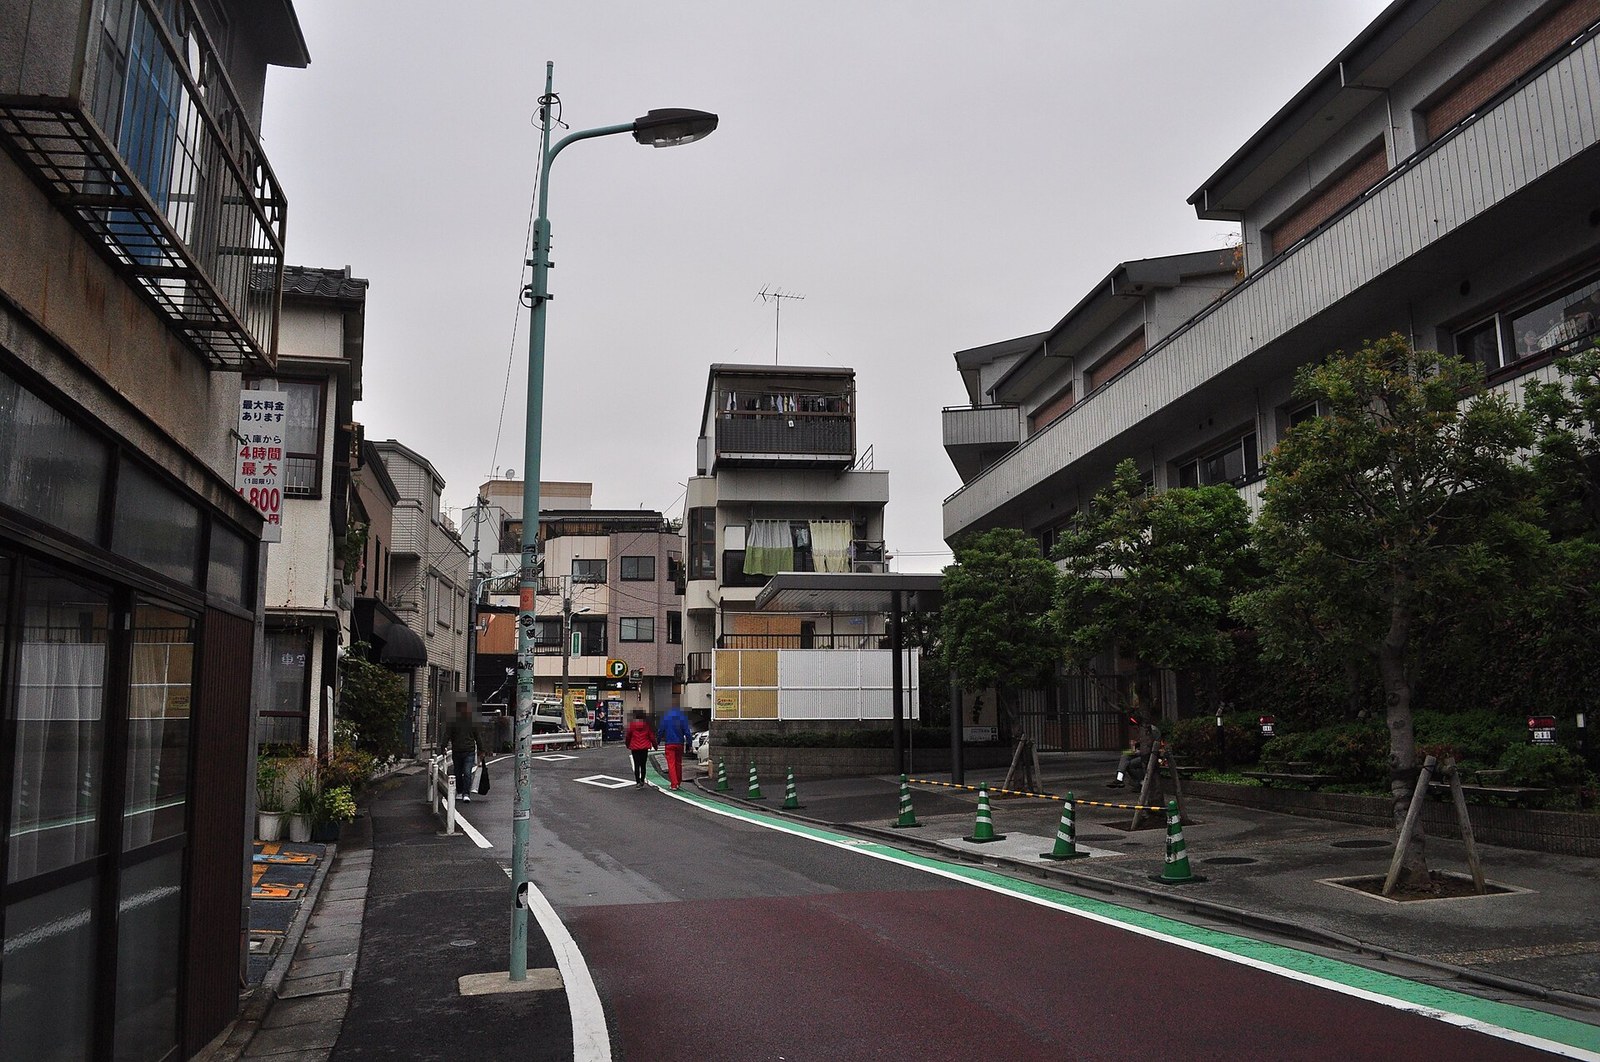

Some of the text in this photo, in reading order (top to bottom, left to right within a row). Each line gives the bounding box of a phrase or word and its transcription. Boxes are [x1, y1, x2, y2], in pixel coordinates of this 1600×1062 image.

[242, 400, 285, 411] 最大料金
[242, 411, 284, 423] あります
[243, 433, 282, 444] 入庫から
[240, 446, 282, 461] 4時間
[268, 513, 280, 525] 円
[614, 662, 625, 675] P
